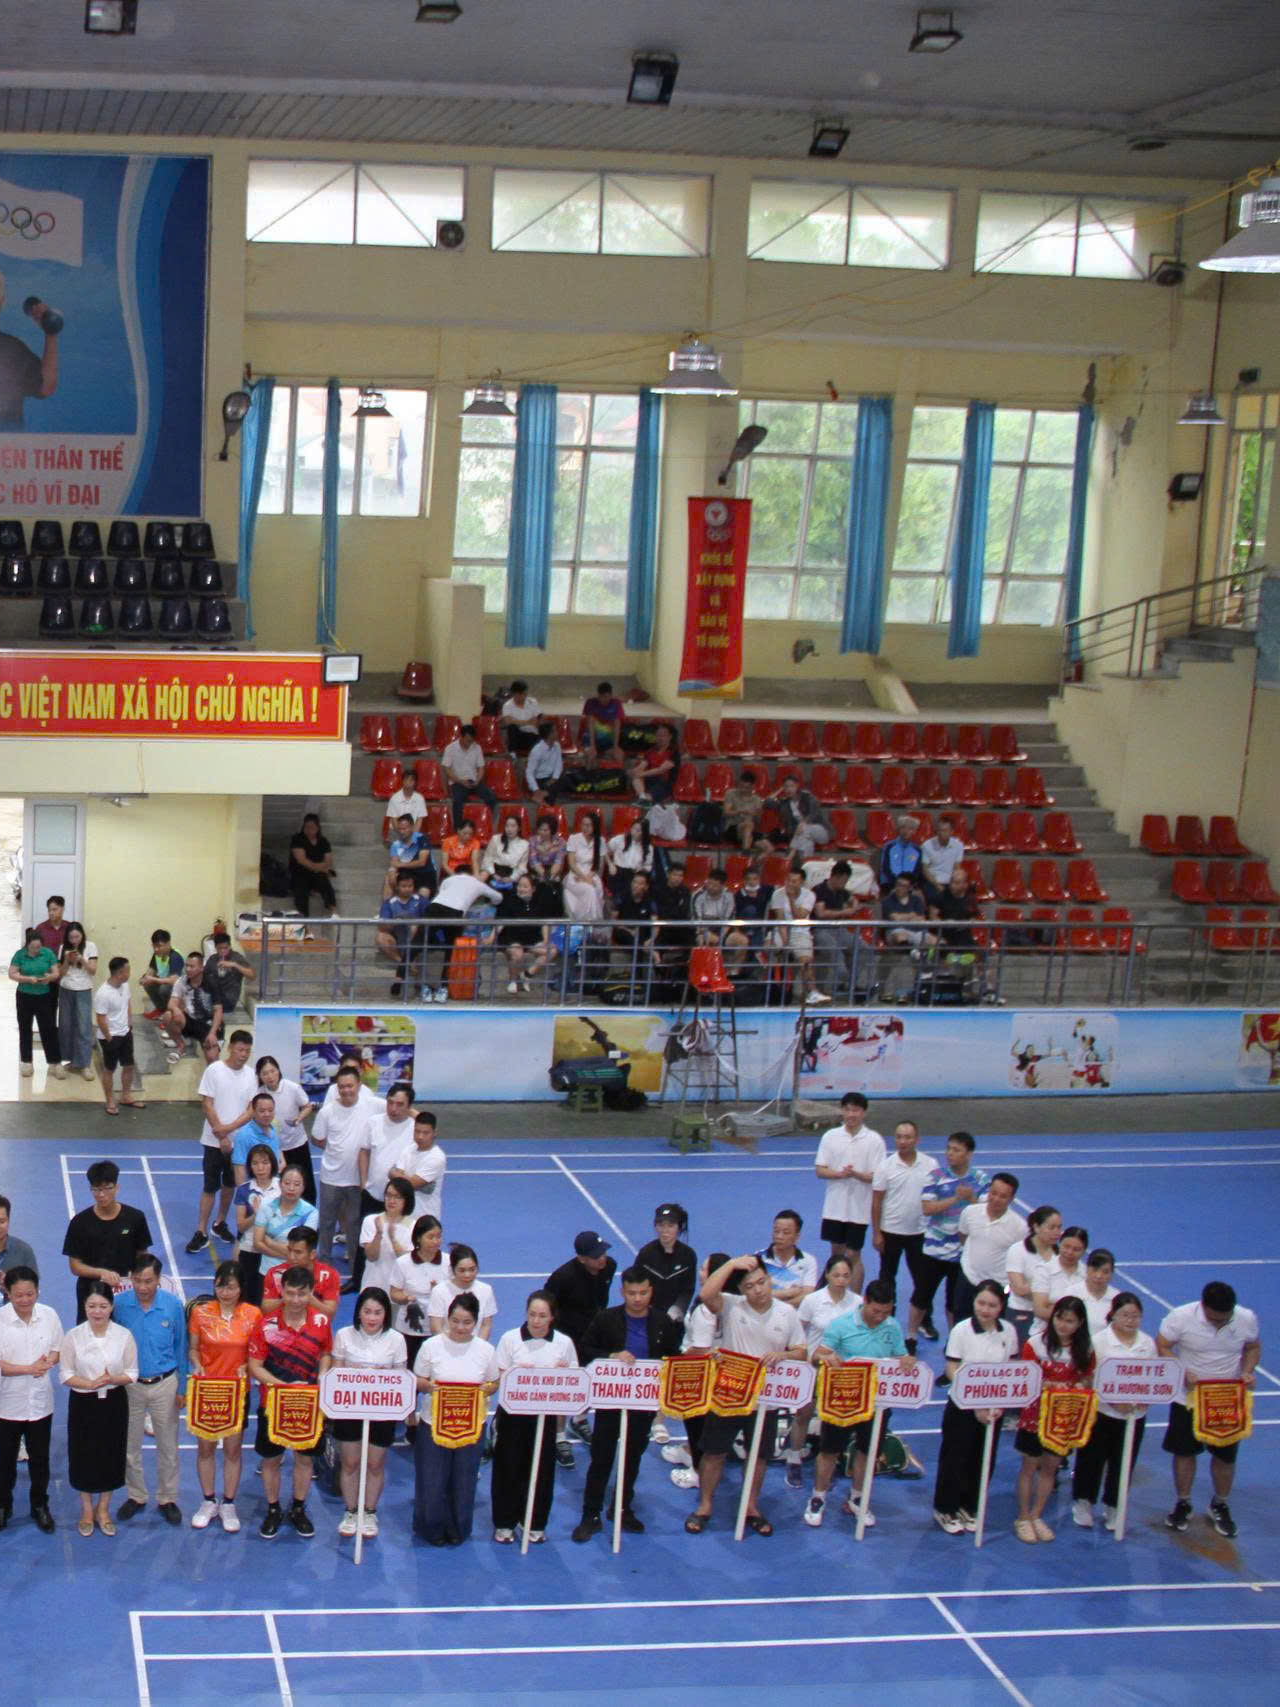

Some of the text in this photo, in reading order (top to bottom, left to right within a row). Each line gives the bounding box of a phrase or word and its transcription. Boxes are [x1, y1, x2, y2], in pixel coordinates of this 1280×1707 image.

[33, 444, 83, 470] THÂN
[89, 441, 125, 471] THỂ
[12, 478, 37, 505] HỒ
[45, 480, 64, 505] VĨ
[67, 484, 100, 510] ĐẠI
[19, 675, 62, 727] VIỆT
[68, 685, 115, 720] NAM
[122, 678, 147, 720] XÃ
[155, 678, 189, 728] HỘI
[196, 673, 236, 722] CHỦ
[241, 679, 304, 723] NGHĨA
[310, 687, 318, 722] !
[595, 1364, 659, 1380] CÂU LẠC BỘ
[786, 1367, 800, 1379] BỘ
[880, 1366, 903, 1378] LẠC
[967, 1365, 1029, 1379] CÂU LẠC BỘ
[1115, 1363, 1166, 1378] TRẠM Y TẾ
[336, 1372, 402, 1385] TRƯỜNG THCS
[517, 1375, 531, 1385] BAN
[542, 1376, 554, 1385] KHU
[592, 1382, 631, 1399] THANH
[635, 1382, 660, 1400] SƠN
[775, 1384, 800, 1400] SƠN
[892, 1383, 920, 1398] SƠN
[964, 1381, 1008, 1398] PHÙNG
[1118, 1382, 1151, 1395] HƯƠNG
[1152, 1383, 1173, 1395] SƠN
[333, 1389, 403, 1409] ĐẠI NGHĨA
[572, 1391, 586, 1402] SƠN
